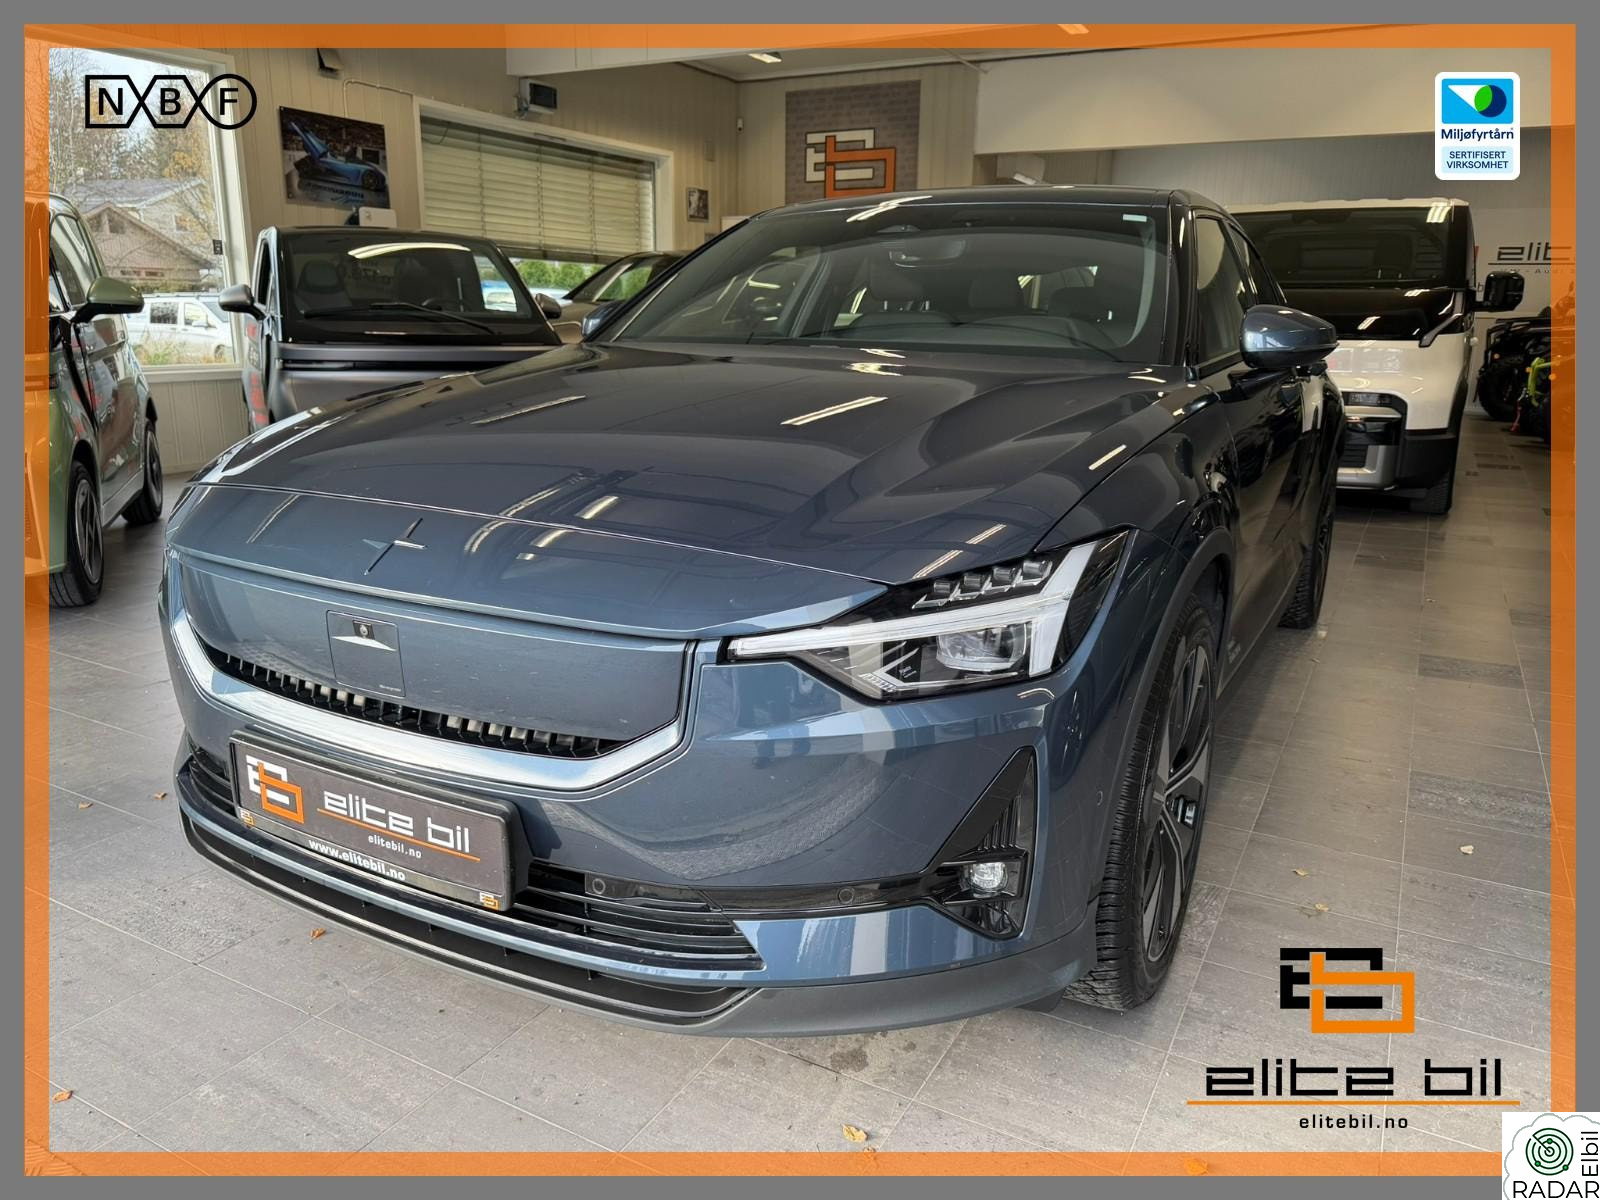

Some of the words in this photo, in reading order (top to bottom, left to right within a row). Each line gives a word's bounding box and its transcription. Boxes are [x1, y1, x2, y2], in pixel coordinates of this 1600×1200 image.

[1497, 242, 1576, 261] elit
[323, 790, 414, 836] elite
[427, 816, 470, 853] bil
[308, 839, 406, 882] www.elitebil.no
[368, 834, 422, 859] elitebil.no
